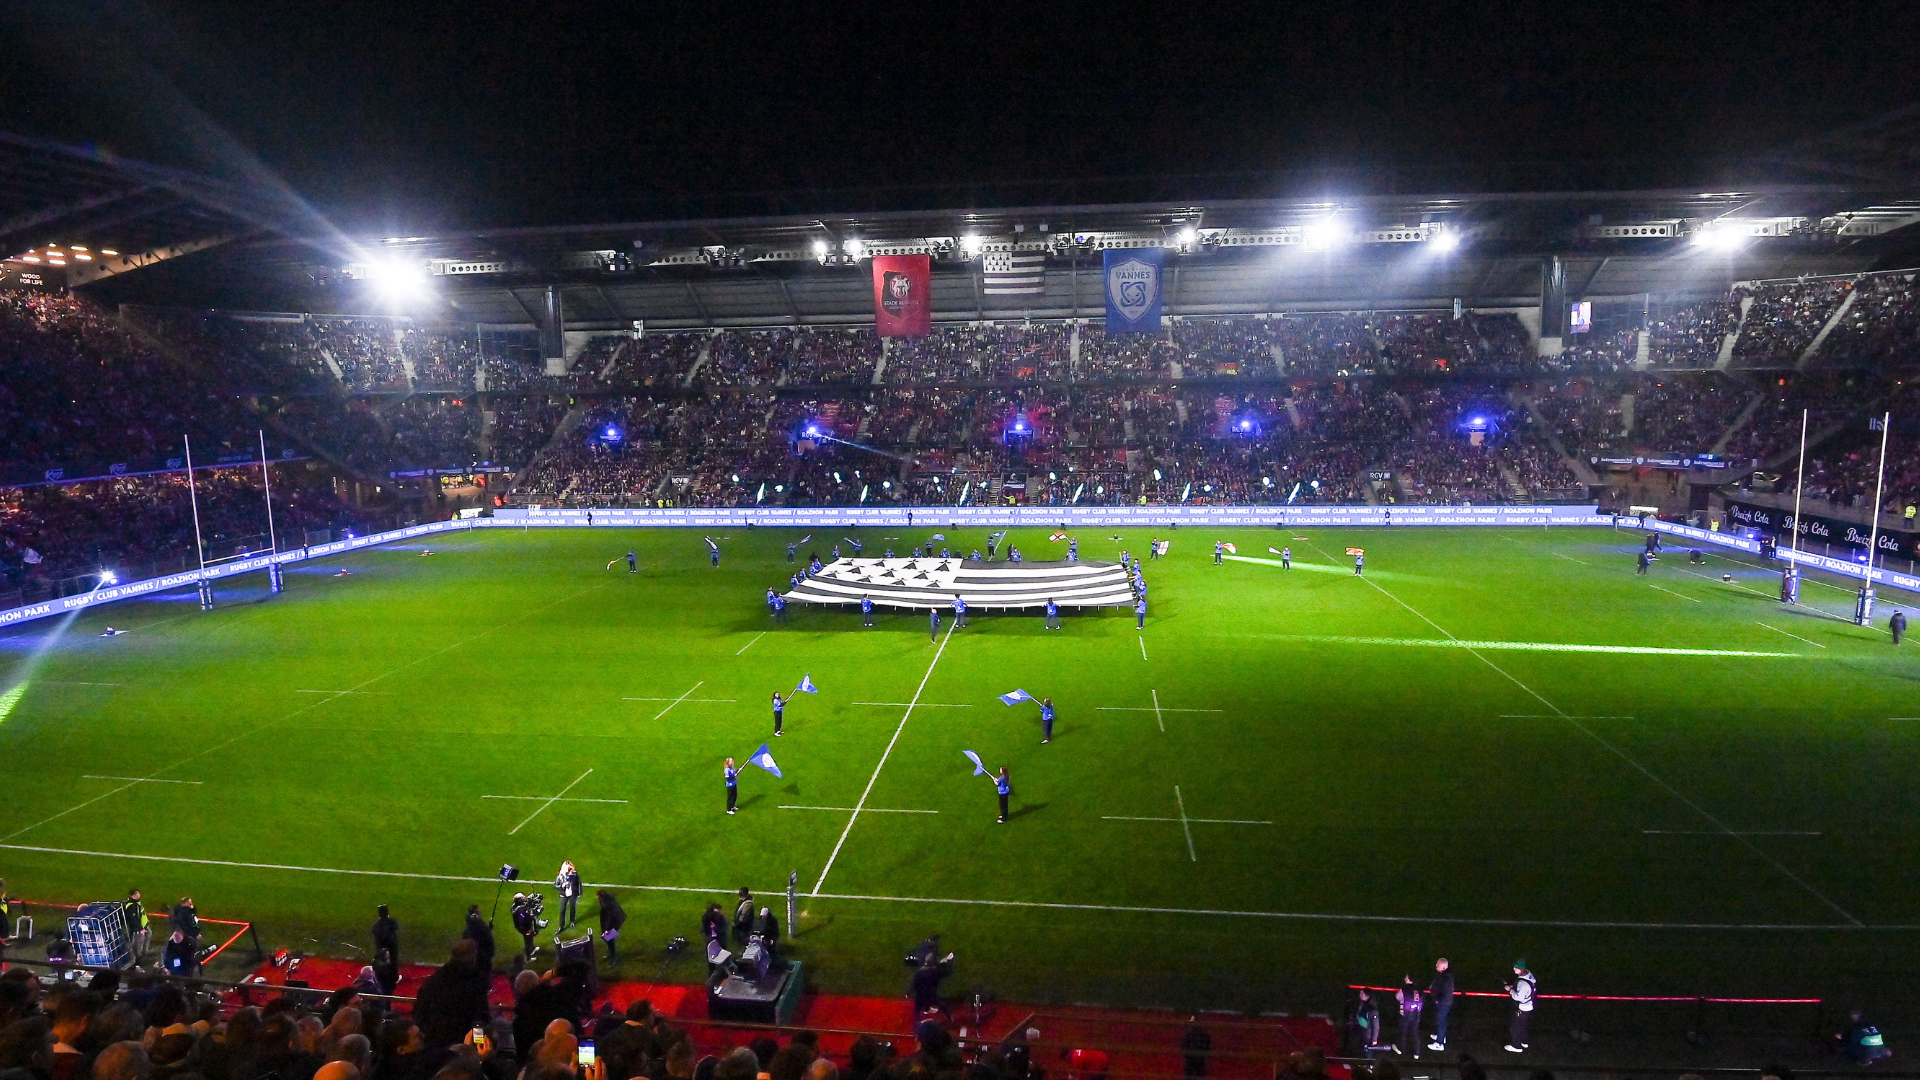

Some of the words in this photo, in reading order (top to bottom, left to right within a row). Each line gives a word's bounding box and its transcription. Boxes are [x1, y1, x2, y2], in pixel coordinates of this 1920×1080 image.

[1116, 271, 1150, 279] VANNES
[1628, 518, 1646, 526] PAK
[1754, 511, 1770, 525] Cola
[1783, 516, 1808, 534] Brizh
[1811, 522, 1828, 536] Cola
[352, 538, 368, 546] RUGBY
[406, 526, 428, 535] ROAZHON
[1655, 522, 1671, 530] RUGBY
[1686, 529, 1704, 538] VANNES
[1709, 534, 1735, 544] ROAZHON
[1736, 540, 1749, 548] PARK
[1845, 527, 1872, 548] Breiz
[1878, 535, 1898, 551] Cola
[230, 562, 251, 572] RUGBY
[254, 558, 269, 566] CLUB
[301, 546, 329, 556] RAZHON
[1826, 559, 1860, 574] ROAZHON
[64, 594, 94, 608] RUGBY
[97, 590, 118, 600] CLUB
[120, 582, 153, 594] VANNES
[162, 573, 199, 586] ROAZHON
[1893, 576, 1920, 588] RUGBY
[25, 605, 50, 617] PARK
